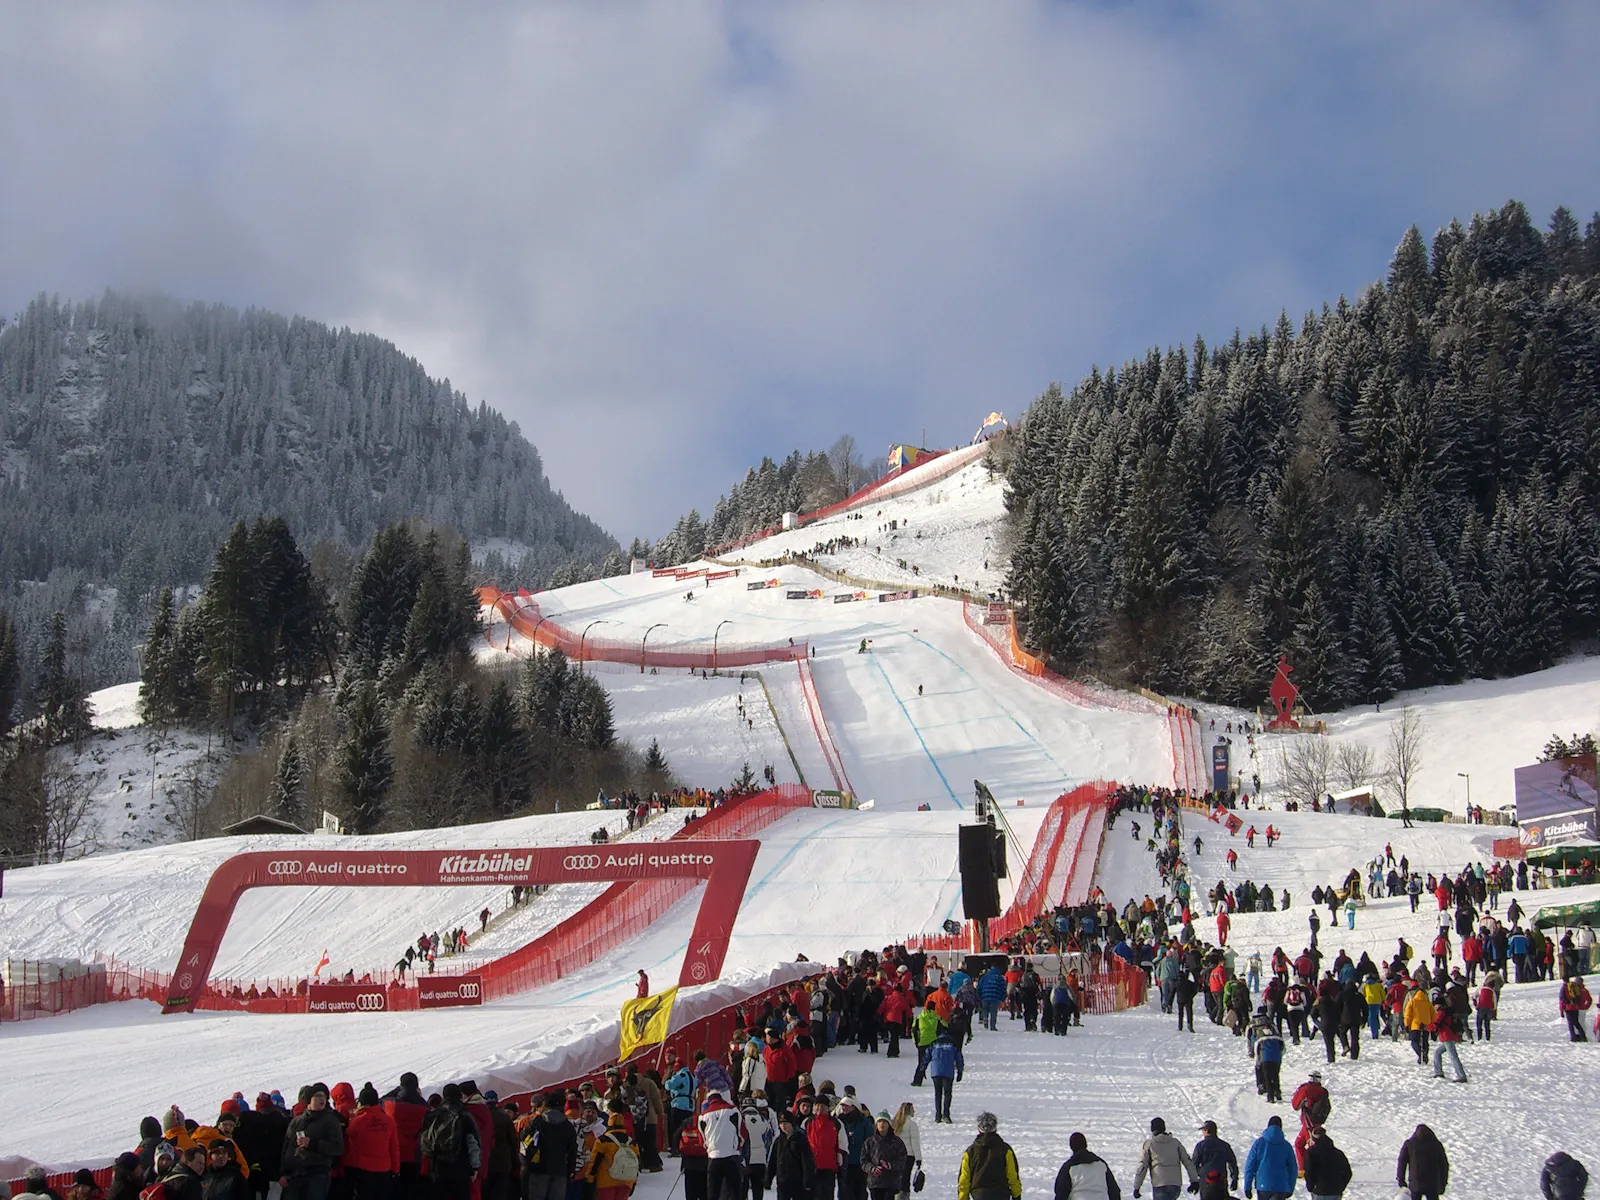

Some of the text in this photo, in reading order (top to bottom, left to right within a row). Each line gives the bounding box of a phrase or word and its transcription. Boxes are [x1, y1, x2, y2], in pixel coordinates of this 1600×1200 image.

[1544, 821, 1587, 836] Kitzbühel
[439, 853, 533, 874] Kitzbühel
[604, 853, 714, 868] Audi quattro
[306, 862, 407, 876] Audi quattro
[440, 874, 528, 882] Hahnenkamm-Rennen
[420, 991, 459, 1000] Audi quattro
[309, 1000, 356, 1011] Audi quattro
